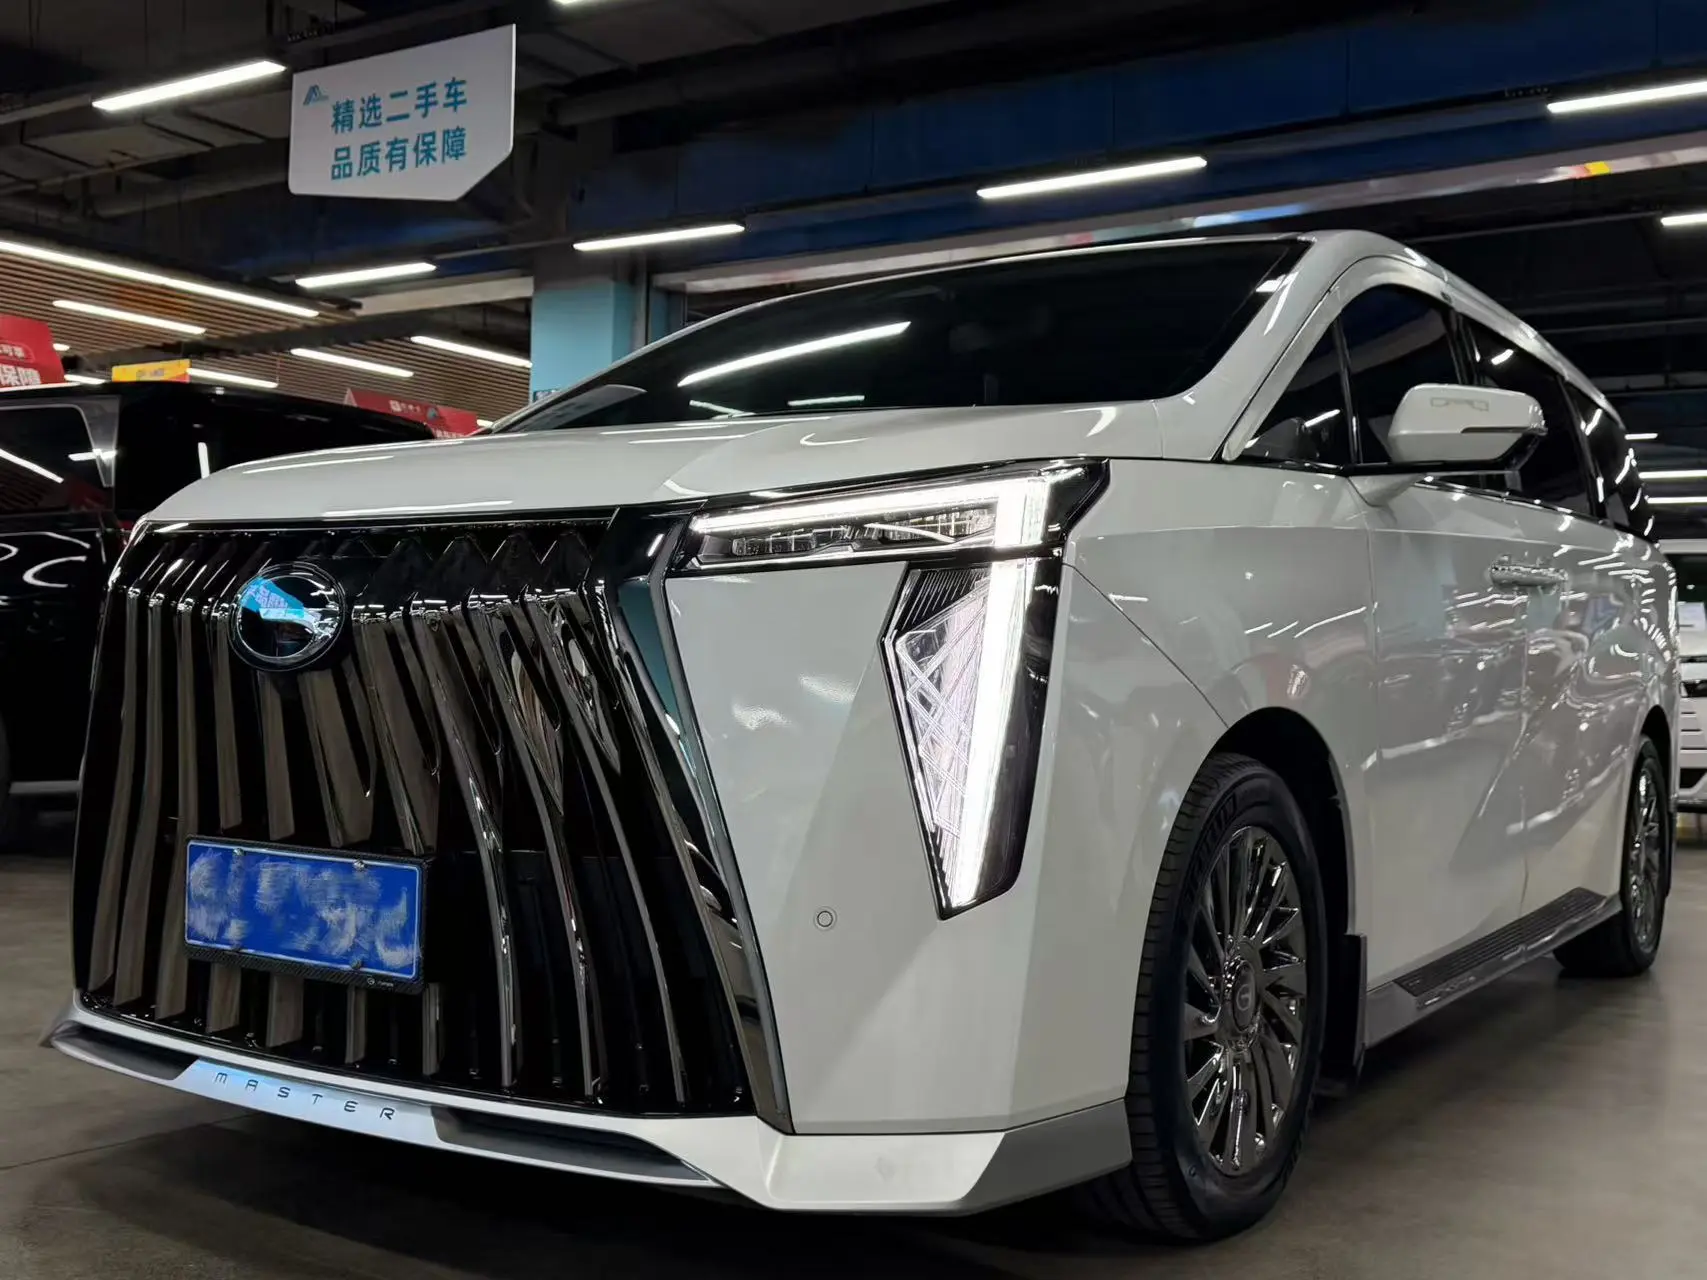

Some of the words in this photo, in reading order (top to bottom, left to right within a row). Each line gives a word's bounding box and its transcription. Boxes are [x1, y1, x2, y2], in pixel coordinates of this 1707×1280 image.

[331, 77, 467, 135] 精选二手车
[331, 126, 467, 180] 品质有保障
[213, 1072, 395, 1120] MASTER
